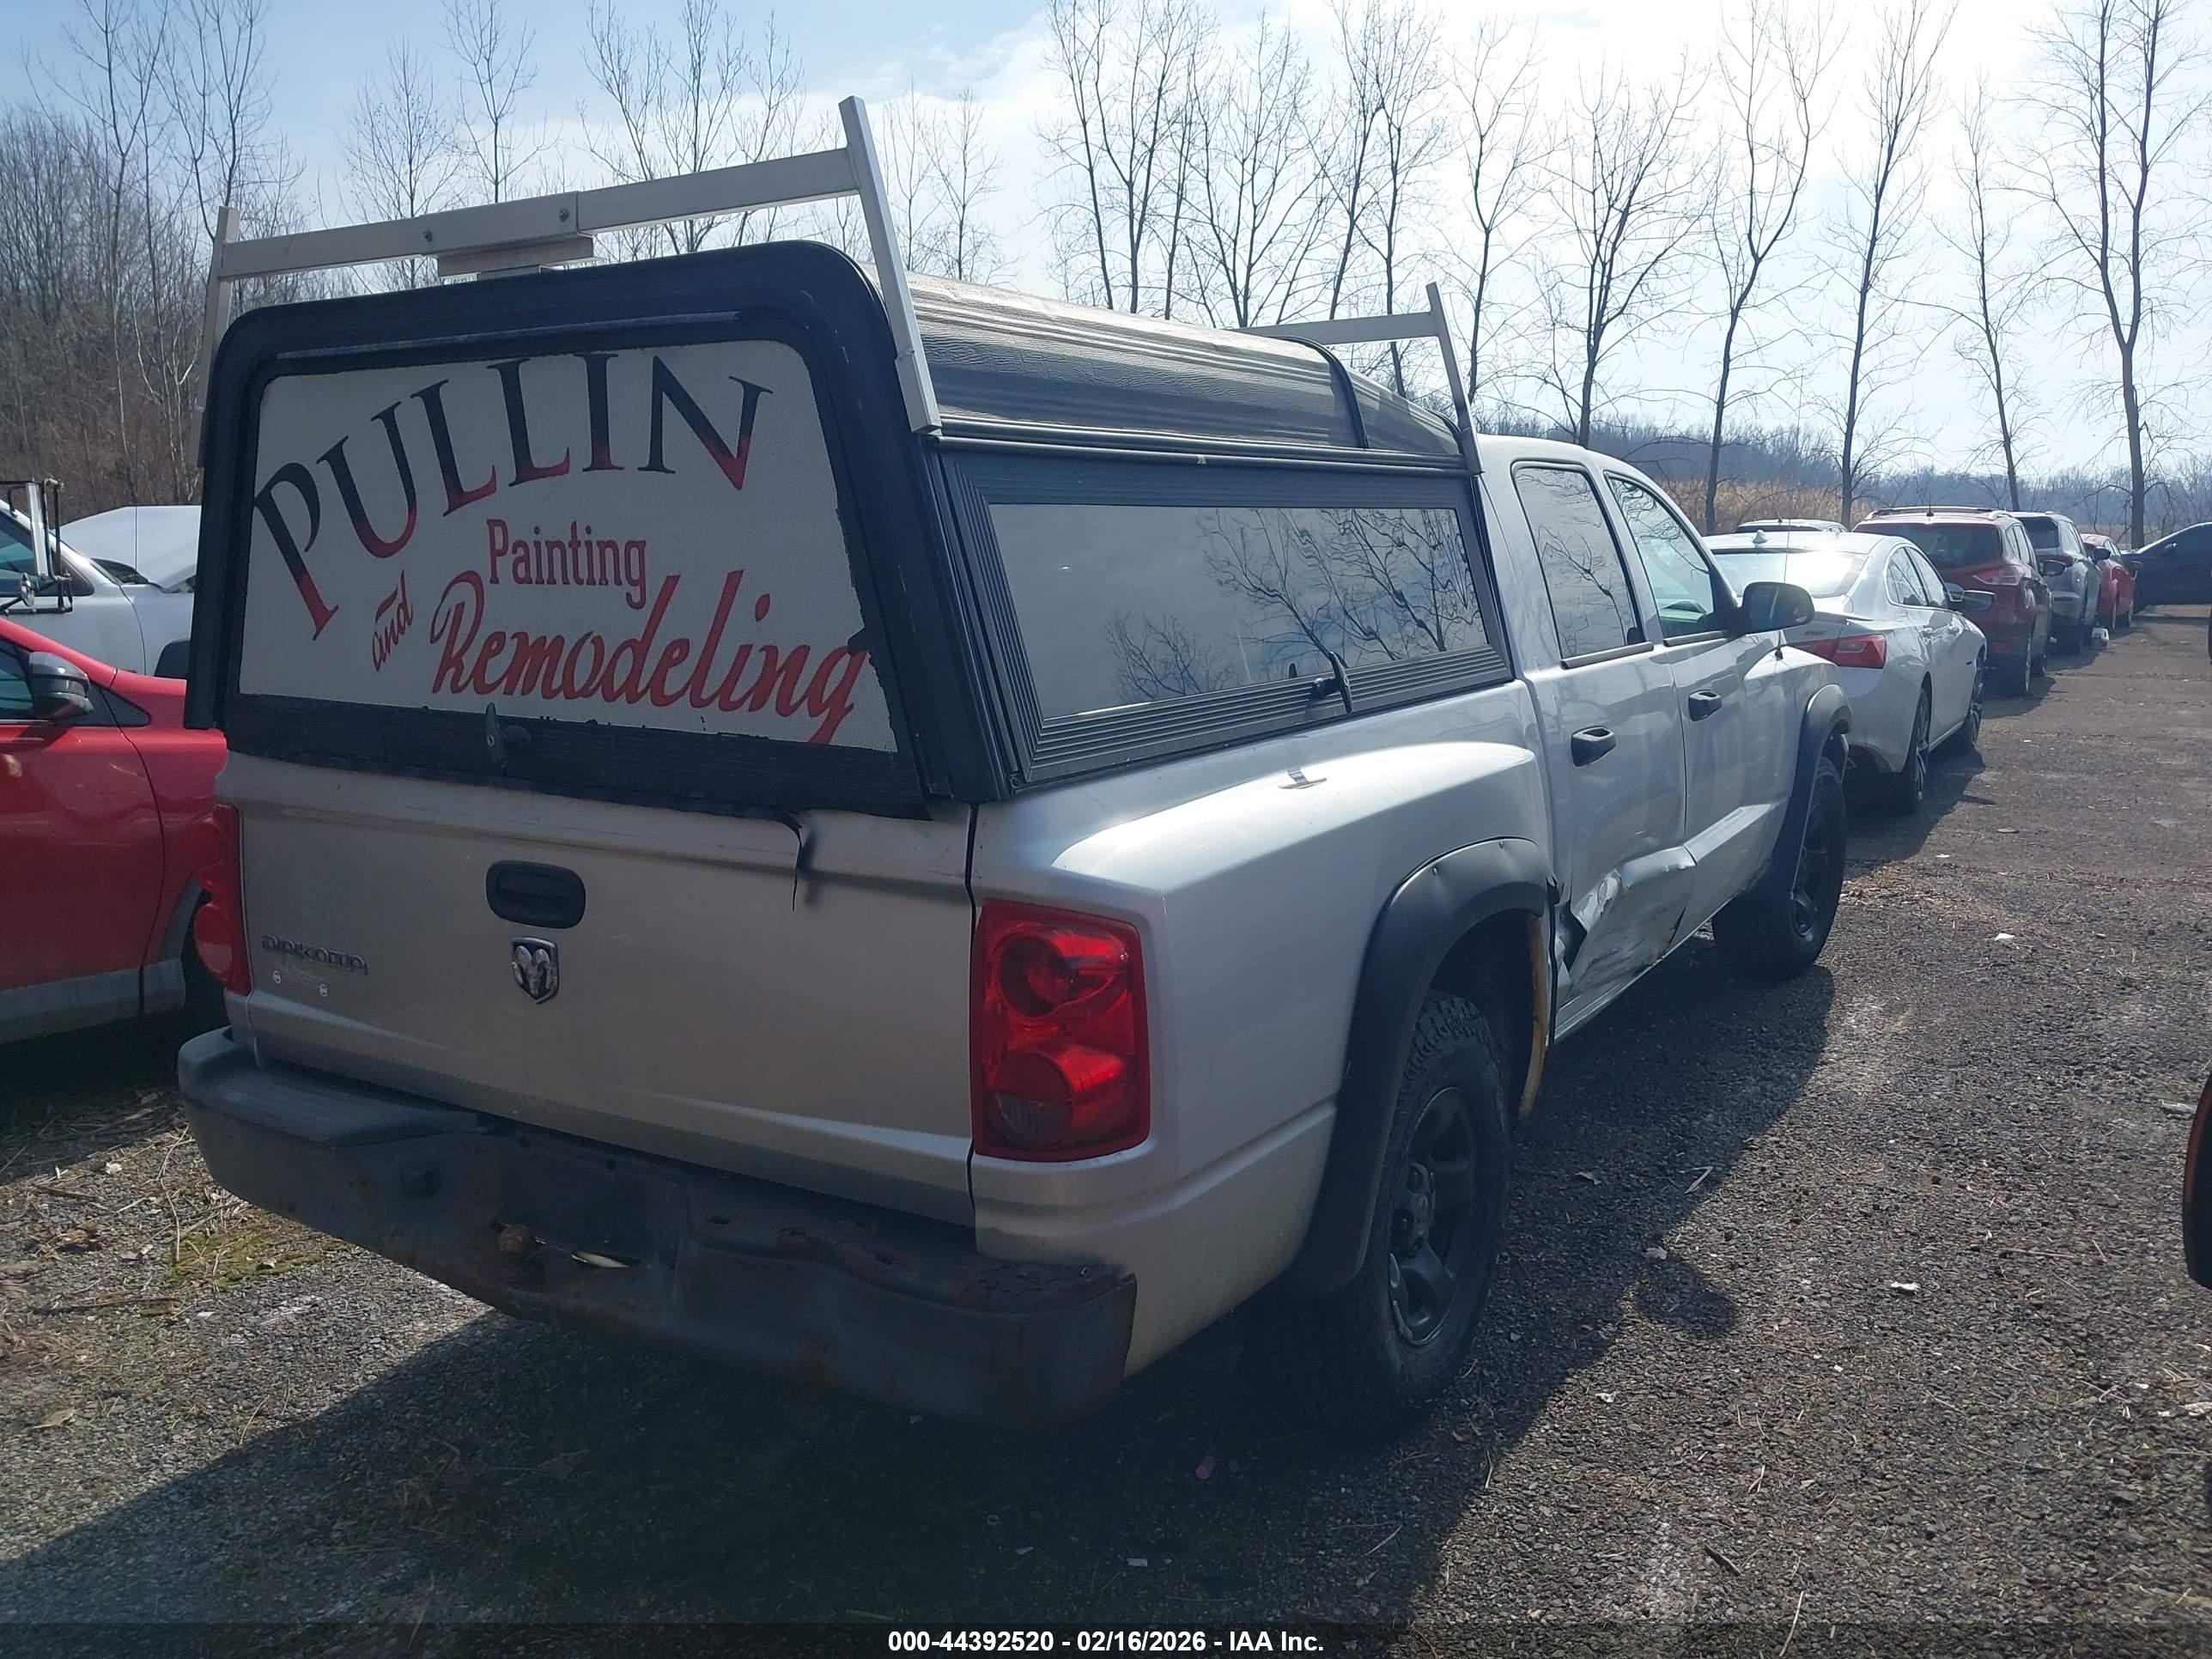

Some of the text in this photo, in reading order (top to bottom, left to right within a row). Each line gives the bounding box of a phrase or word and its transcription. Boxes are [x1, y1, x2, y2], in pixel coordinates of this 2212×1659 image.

[253, 353, 773, 641] PULLIN
[486, 518, 647, 610] Painting
[371, 568, 867, 745] and Remodeling
[261, 934, 368, 975] DAKOTA
